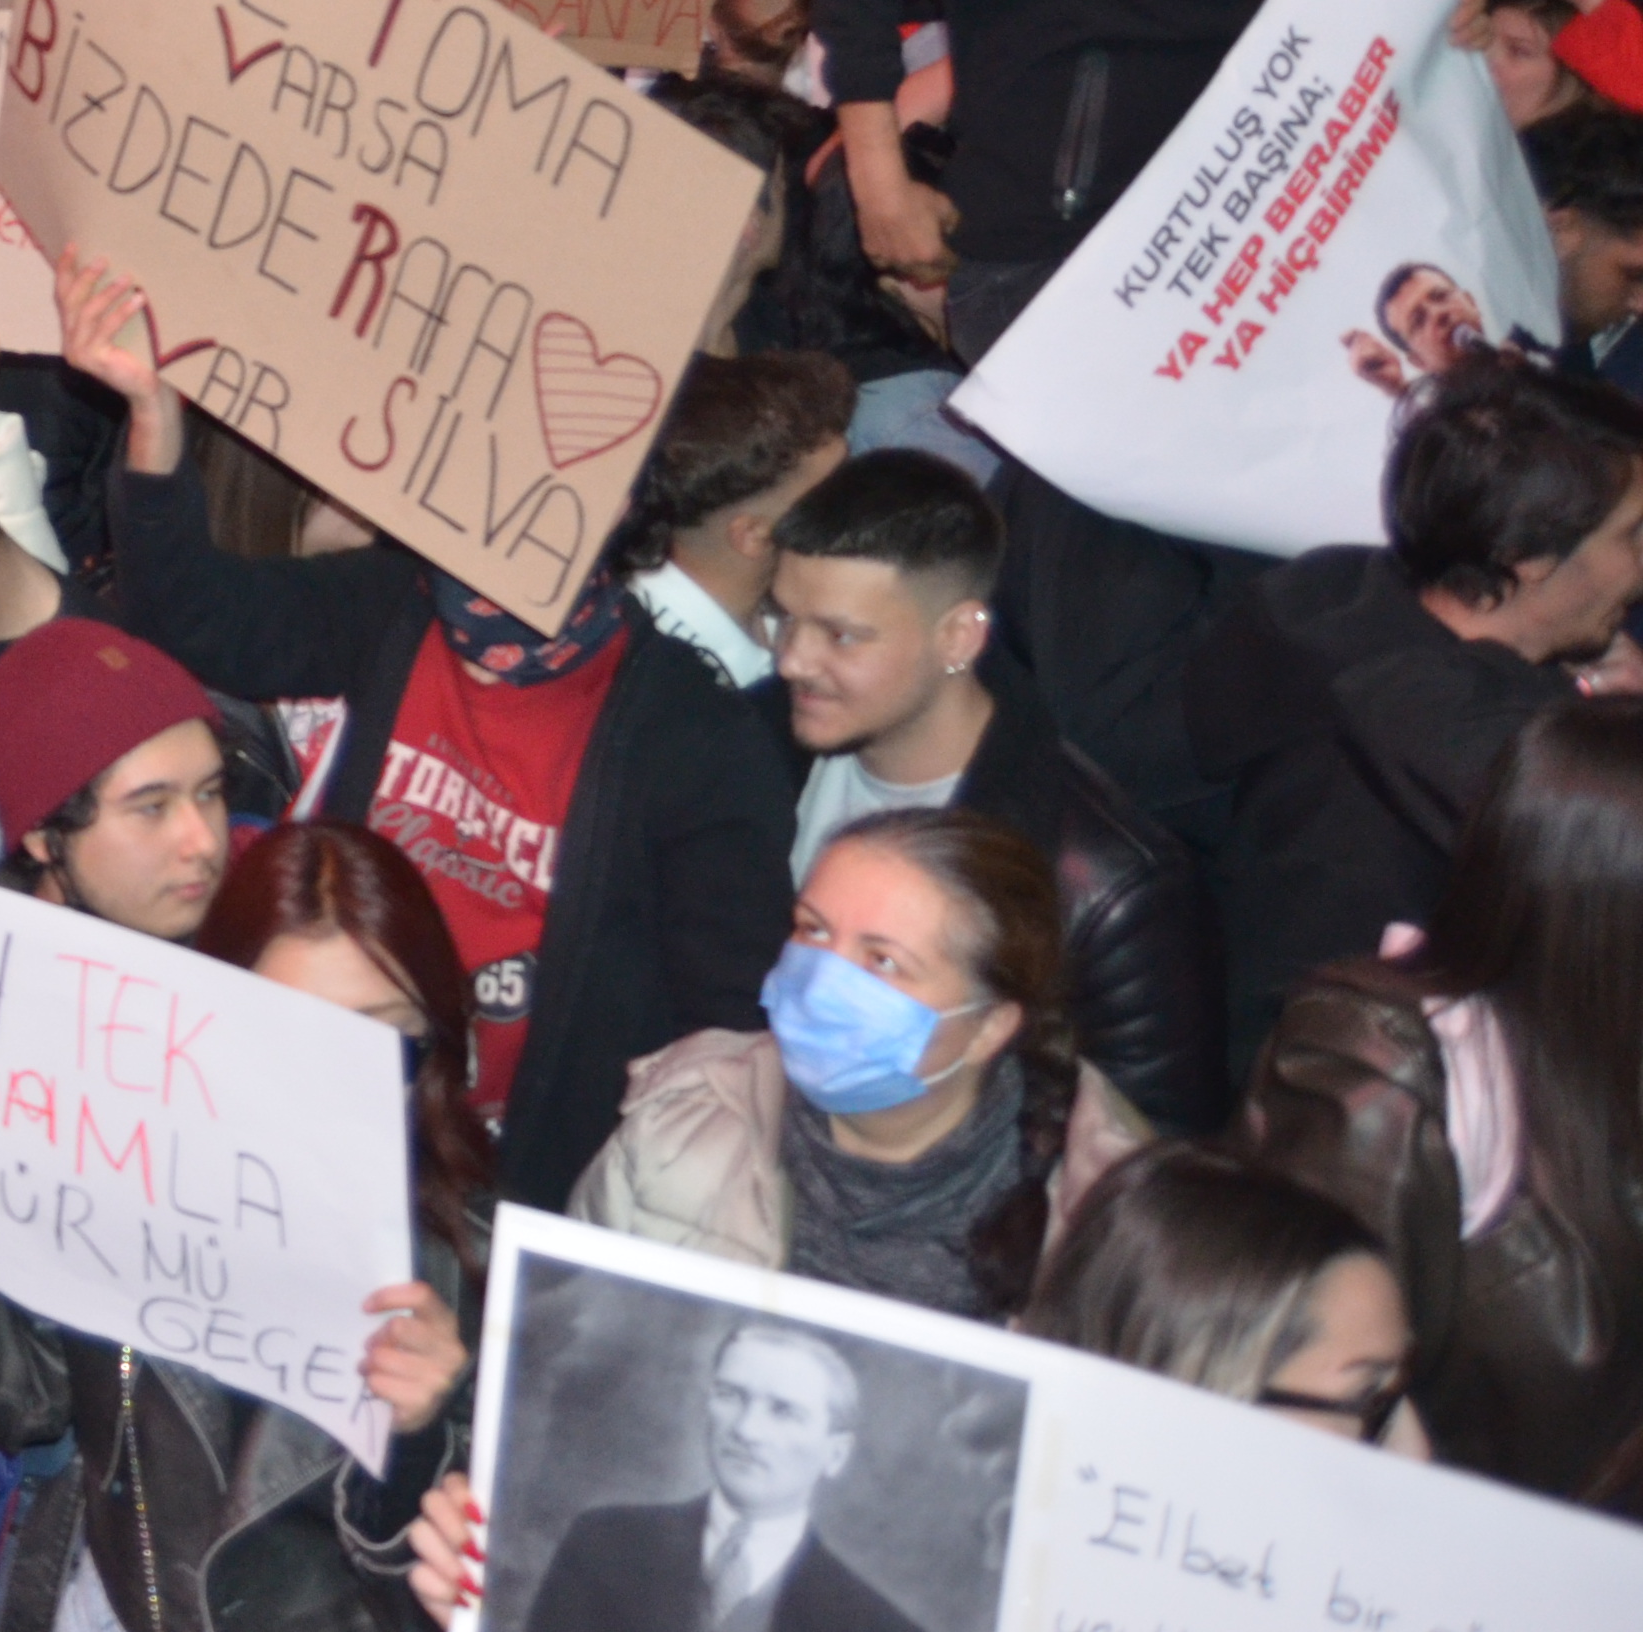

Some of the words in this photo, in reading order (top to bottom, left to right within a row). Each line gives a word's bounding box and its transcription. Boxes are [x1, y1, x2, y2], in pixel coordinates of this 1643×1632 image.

[215, 3, 451, 206] VARSA
[1112, 101, 1268, 311] KURTULUŞ
[1253, 23, 1313, 101] YOK
[1165, 227, 1231, 302] TEK
[1223, 74, 1336, 229] BAŞINA;
[1153, 329, 1209, 385] YA
[1202, 232, 1267, 328] HEP
[1264, 34, 1396, 237] BERABER
[134, 285, 293, 458] VAR
[328, 200, 534, 423] RAFA
[1211, 320, 1266, 374] YA
[55, 953, 219, 1122] TEK
[474, 960, 526, 1009] 65
[1324, 1567, 1399, 1631] bir
